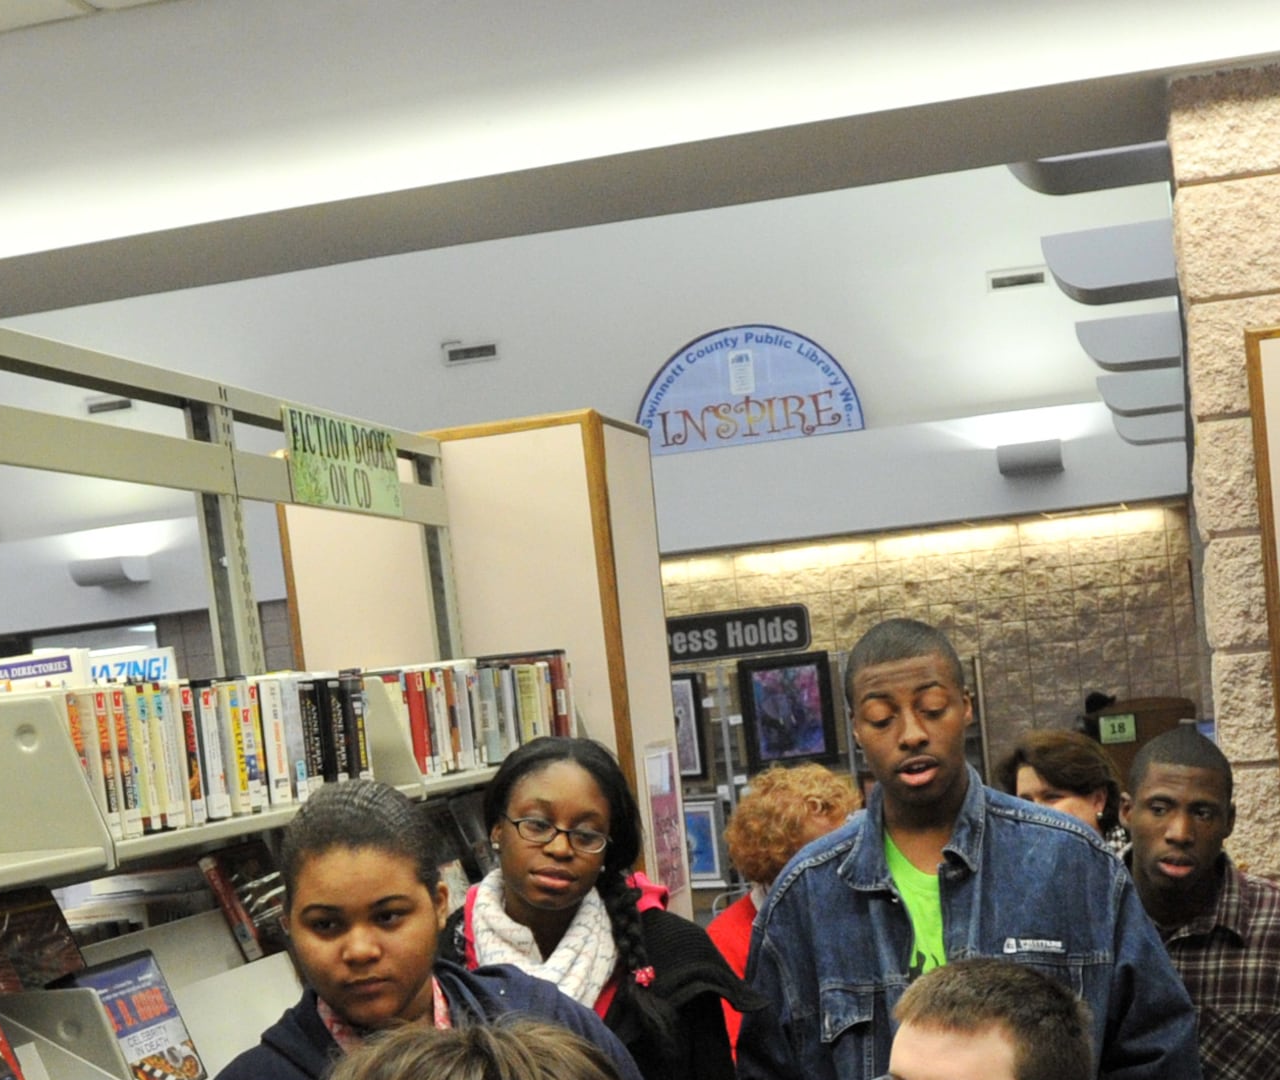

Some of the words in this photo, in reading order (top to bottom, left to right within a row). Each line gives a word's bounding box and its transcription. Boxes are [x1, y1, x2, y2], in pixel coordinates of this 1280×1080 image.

[685, 335, 739, 365] County
[744, 332, 793, 350] Public
[795, 343, 843, 387] Library
[657, 389, 843, 448] INSPIRE
[289, 409, 350, 462] FICTION
[351, 425, 396, 471] BOOKS
[329, 464, 351, 506] ON
[353, 468, 373, 509] CD
[726, 616, 799, 648] Holds
[10, 660, 68, 680] DIRECTORIES
[127, 1025, 168, 1048] CELEBRITY
[135, 1045, 146, 1056] IN
[144, 1038, 170, 1053] DEATH
